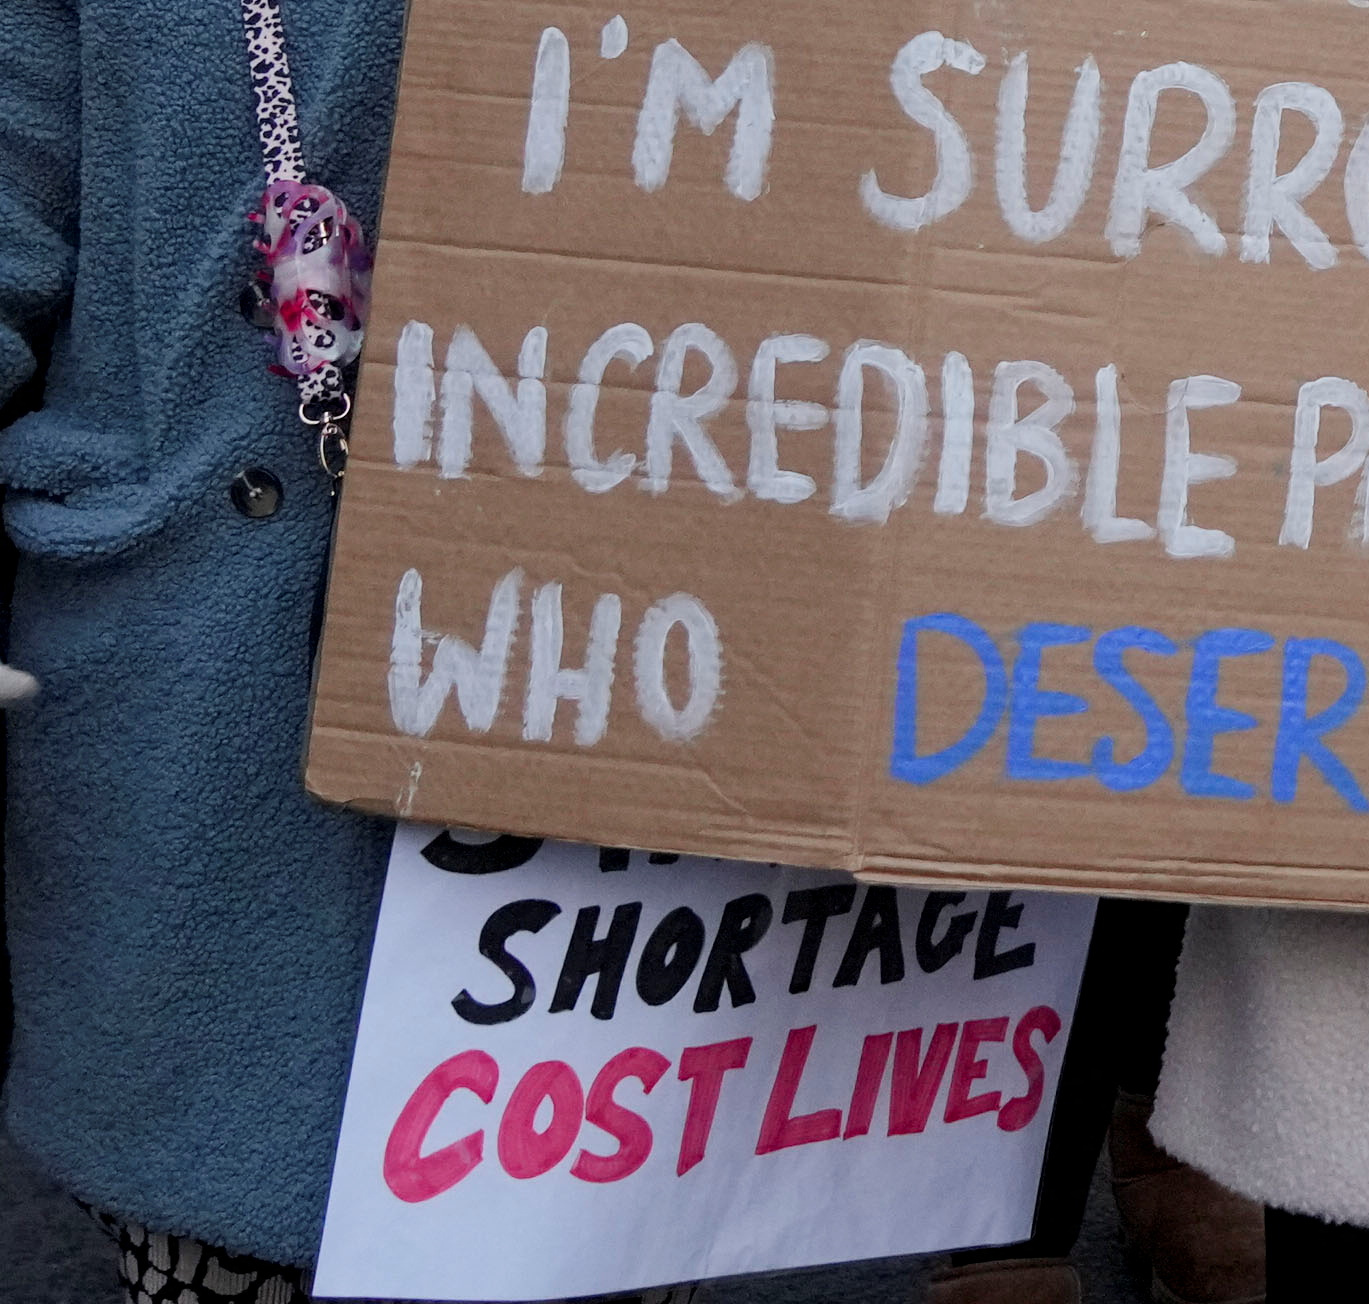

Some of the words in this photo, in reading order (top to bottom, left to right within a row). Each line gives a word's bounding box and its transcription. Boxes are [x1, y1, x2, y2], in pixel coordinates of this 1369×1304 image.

[522, 14, 776, 202] I'M
[393, 320, 1242, 560] INCREDIBLE
[387, 567, 725, 747] WHO
[450, 882, 1038, 1027] SHORTAGE
[382, 1034, 754, 1205] COST
[754, 1004, 1063, 1157] LIVES
